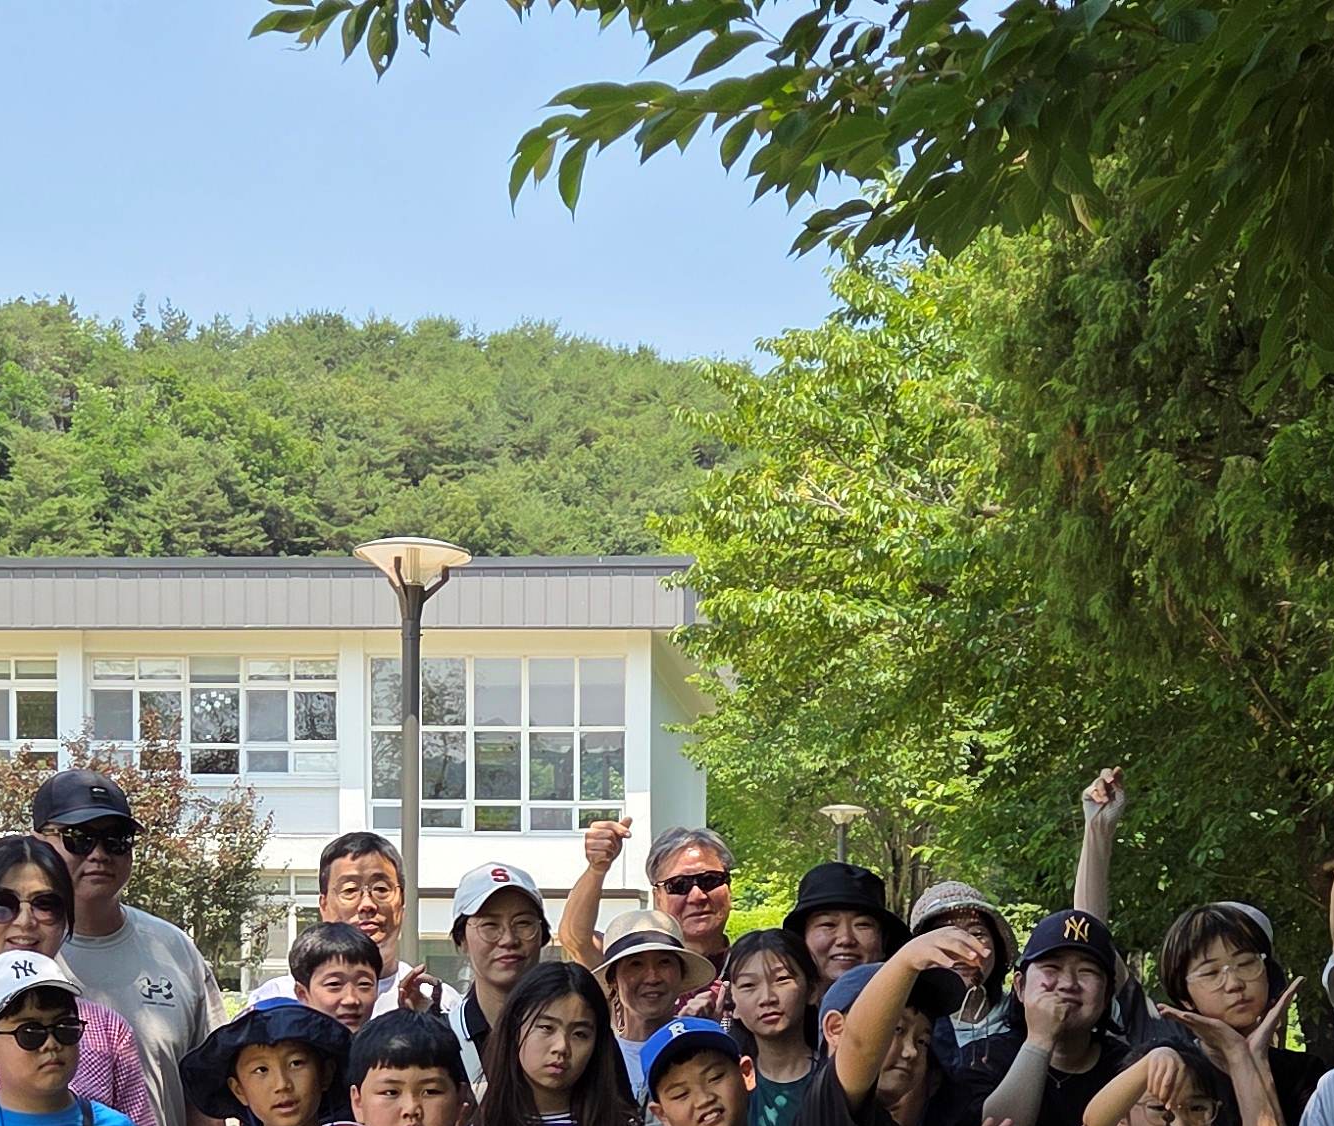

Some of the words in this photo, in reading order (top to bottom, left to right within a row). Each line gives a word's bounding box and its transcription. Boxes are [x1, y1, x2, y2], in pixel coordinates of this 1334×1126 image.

[491, 868, 510, 883] S
[1064, 915, 1090, 943] NY
[11, 960, 37, 979] NY
